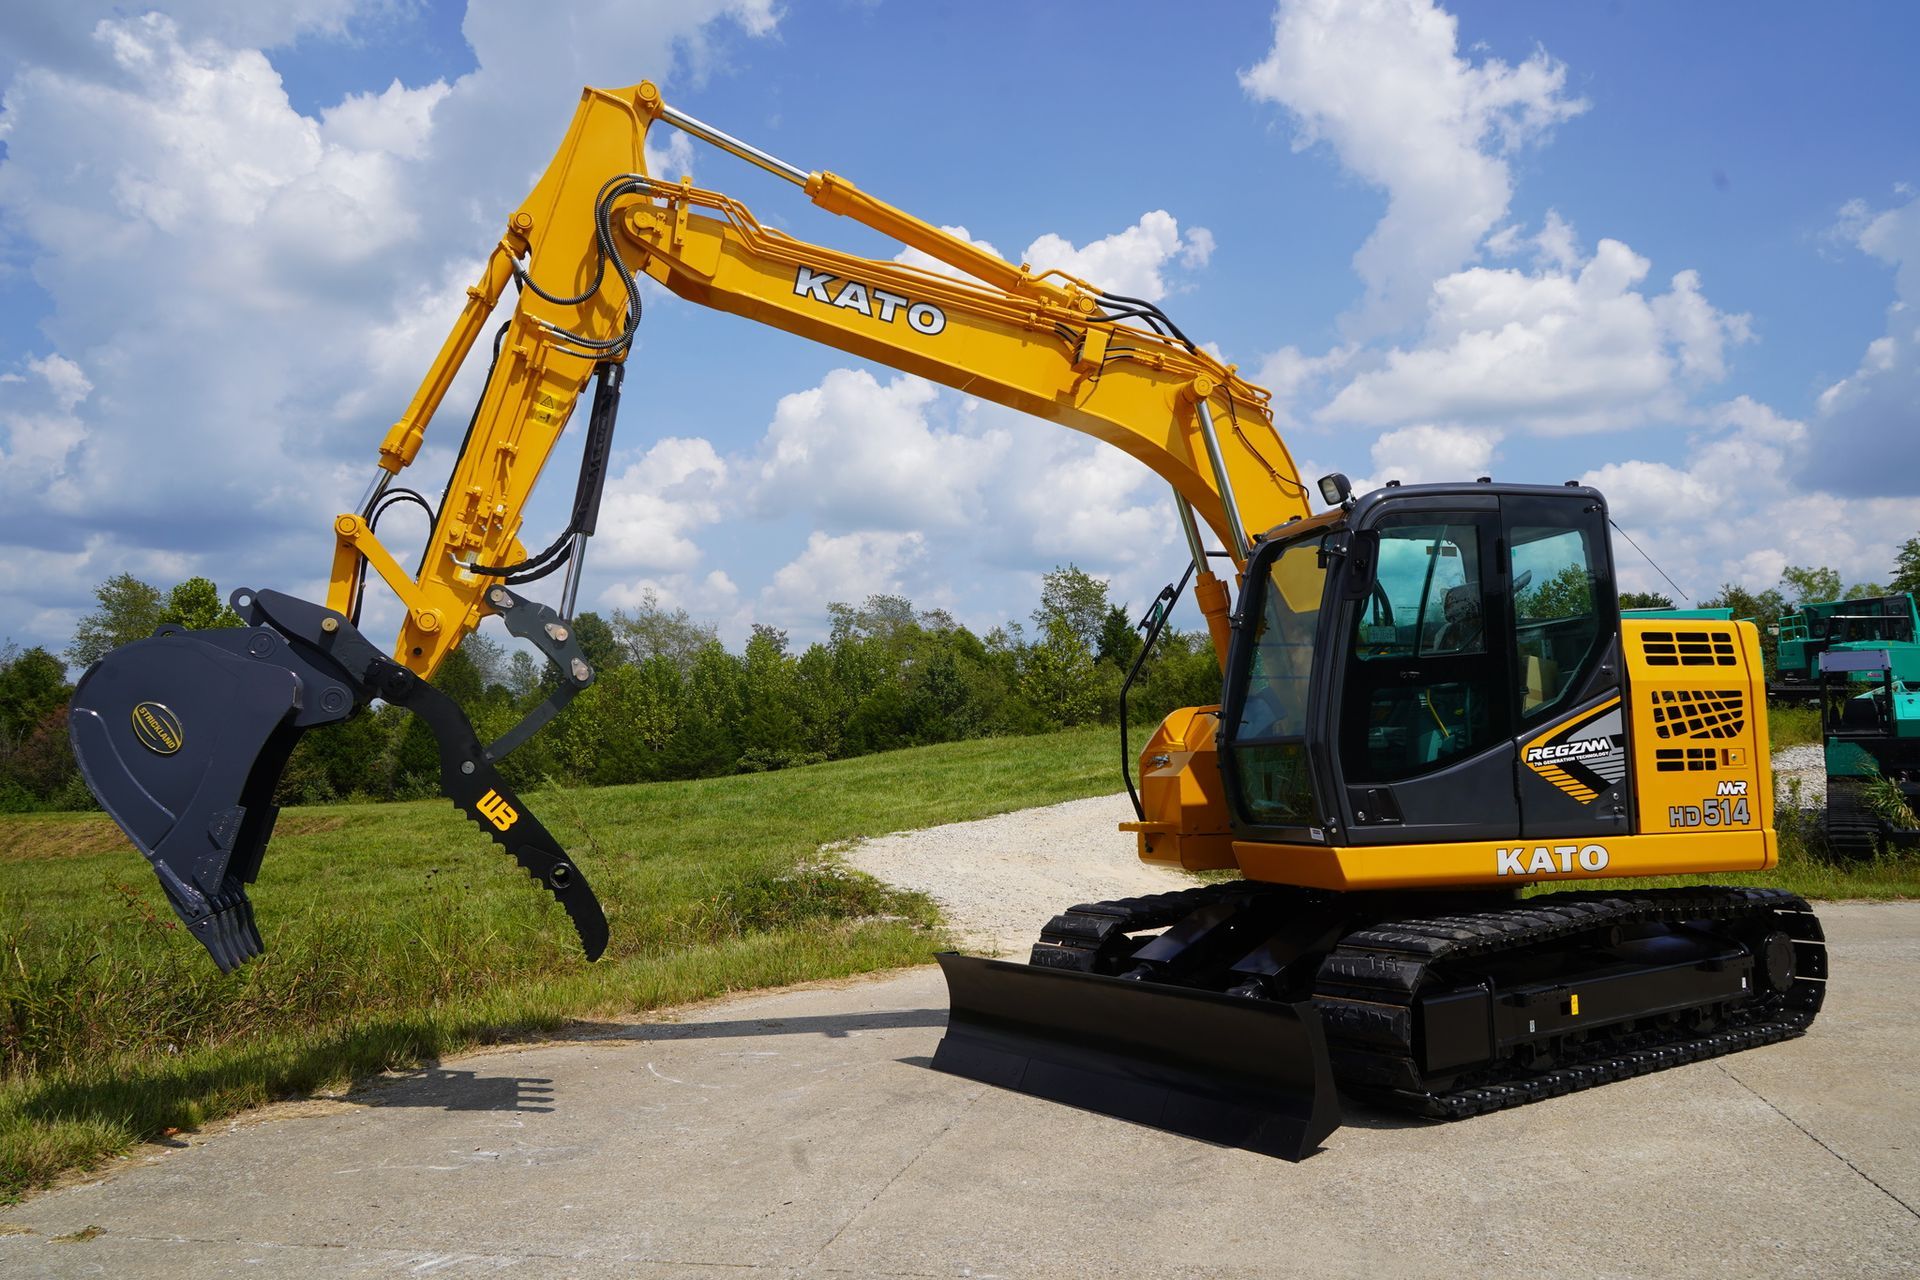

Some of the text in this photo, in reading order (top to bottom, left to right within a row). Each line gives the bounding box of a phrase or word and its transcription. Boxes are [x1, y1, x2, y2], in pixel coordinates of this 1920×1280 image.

[793, 265, 946, 336] KATO
[139, 706, 176, 749] STRICKLAND
[1716, 781, 1748, 796] MR
[1496, 844, 1609, 876] KATO
